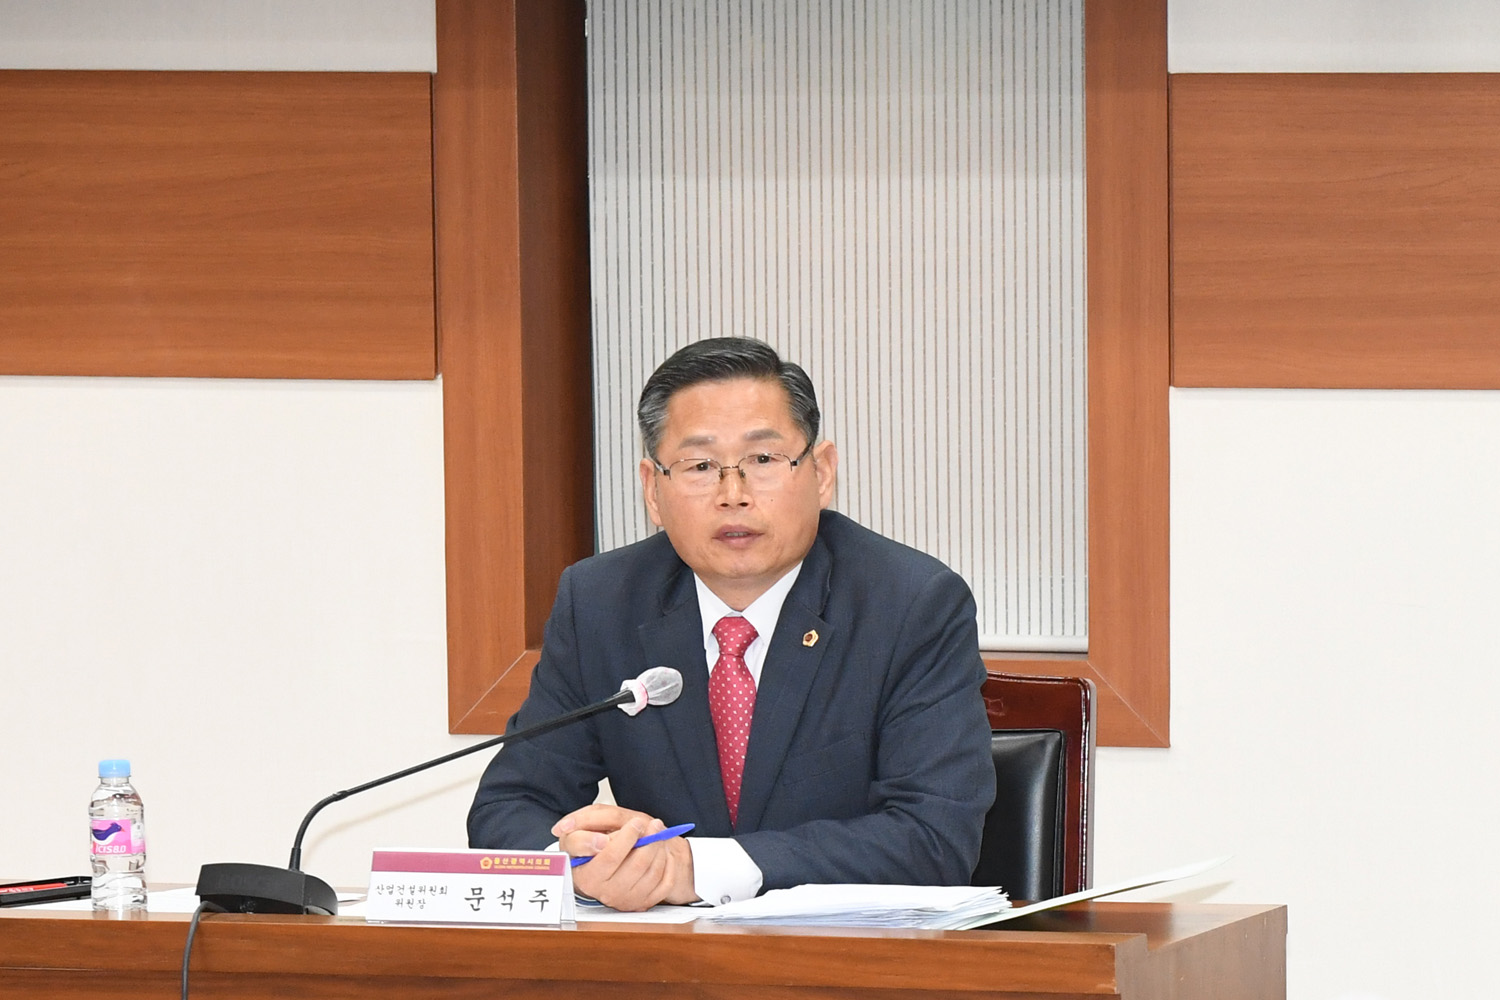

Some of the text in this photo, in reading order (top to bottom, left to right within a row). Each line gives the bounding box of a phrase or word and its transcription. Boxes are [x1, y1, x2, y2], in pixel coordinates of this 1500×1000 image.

[376, 884, 448, 896] 산업건설위원회
[395, 898, 426, 909] 위원장
[464, 887, 550, 912] 문석주
